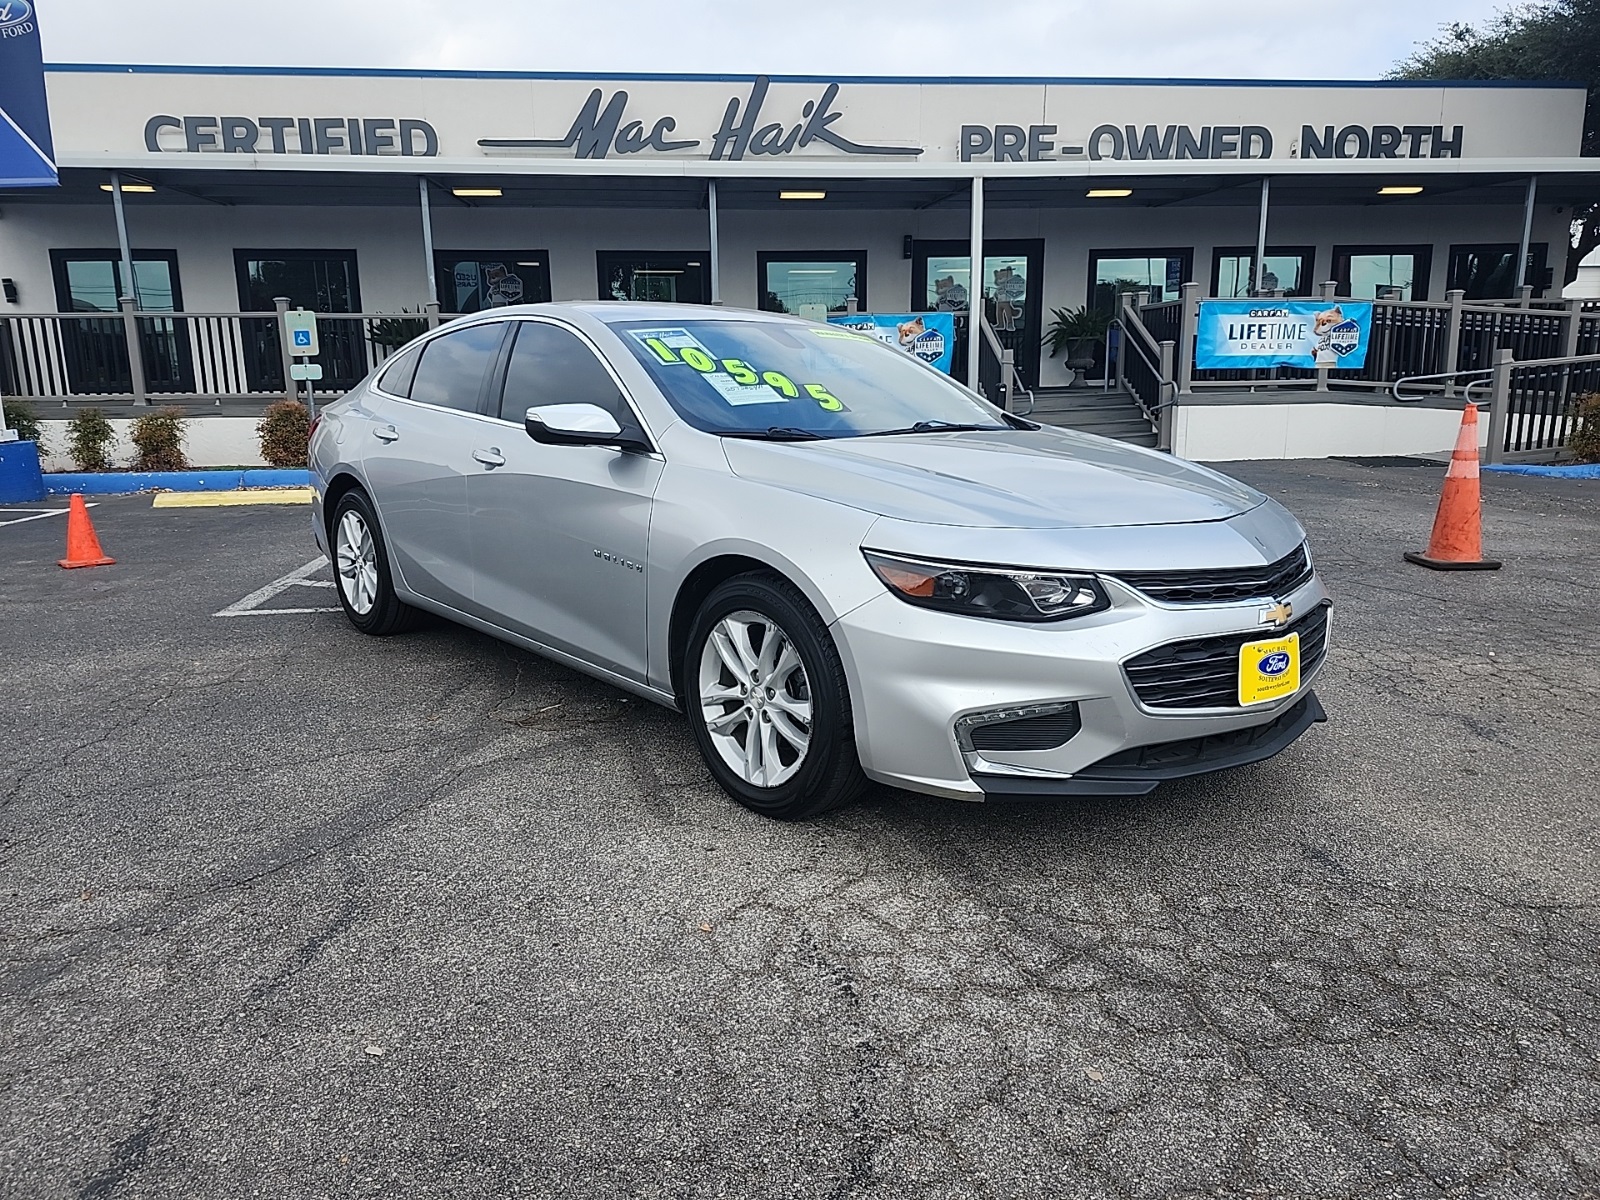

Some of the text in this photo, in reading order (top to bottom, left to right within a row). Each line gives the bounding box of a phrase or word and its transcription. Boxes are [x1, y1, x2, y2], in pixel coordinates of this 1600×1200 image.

[2, 22, 33, 38] FORD
[144, 114, 439, 157] CERTIFIED
[477, 75, 924, 161] Mac Haik
[960, 124, 1464, 162] PRE-OWNED NORTH
[1228, 323, 1307, 340] LIFETIME
[645, 338, 844, 412] 10595
[1266, 655, 1288, 672] Ford
